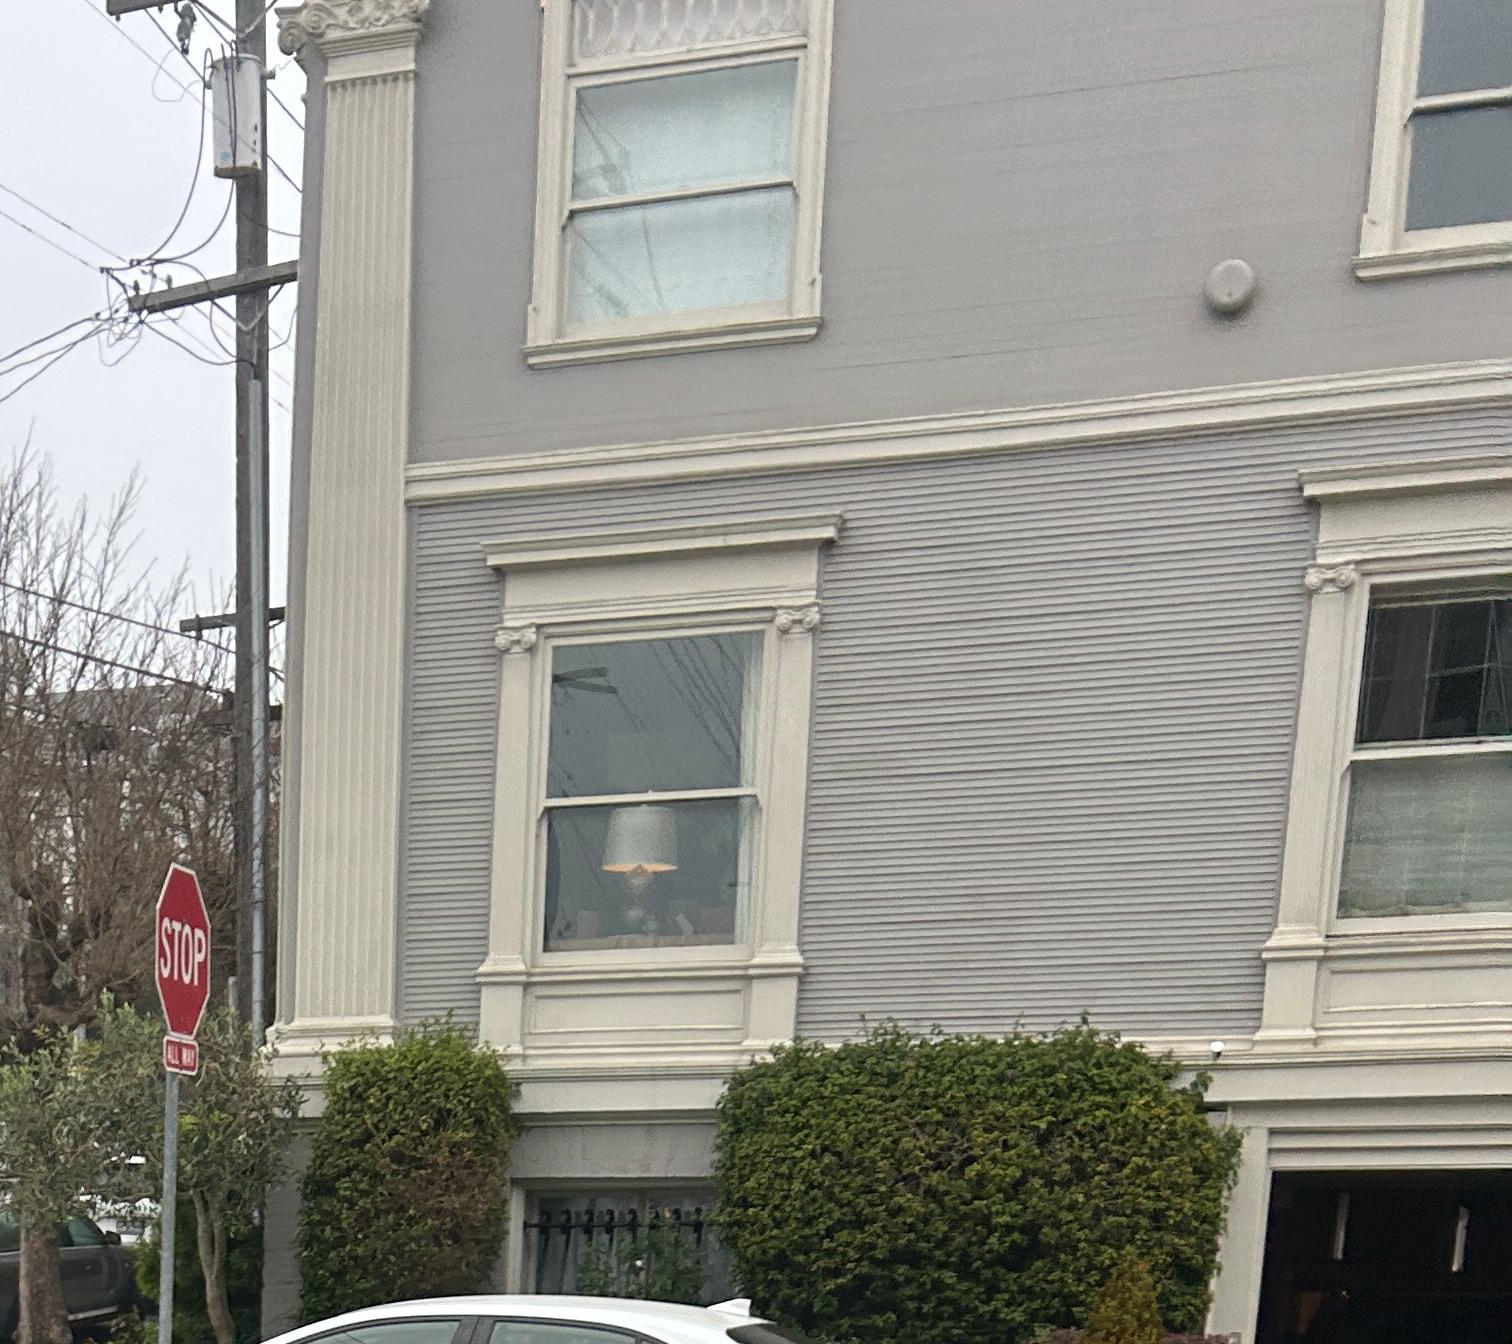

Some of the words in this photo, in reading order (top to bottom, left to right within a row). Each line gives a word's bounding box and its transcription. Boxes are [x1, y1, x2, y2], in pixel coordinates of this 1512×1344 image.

[160, 916, 206, 986] STOP
[167, 1044, 180, 1064] ALL
[181, 1046, 195, 1066] WAY
